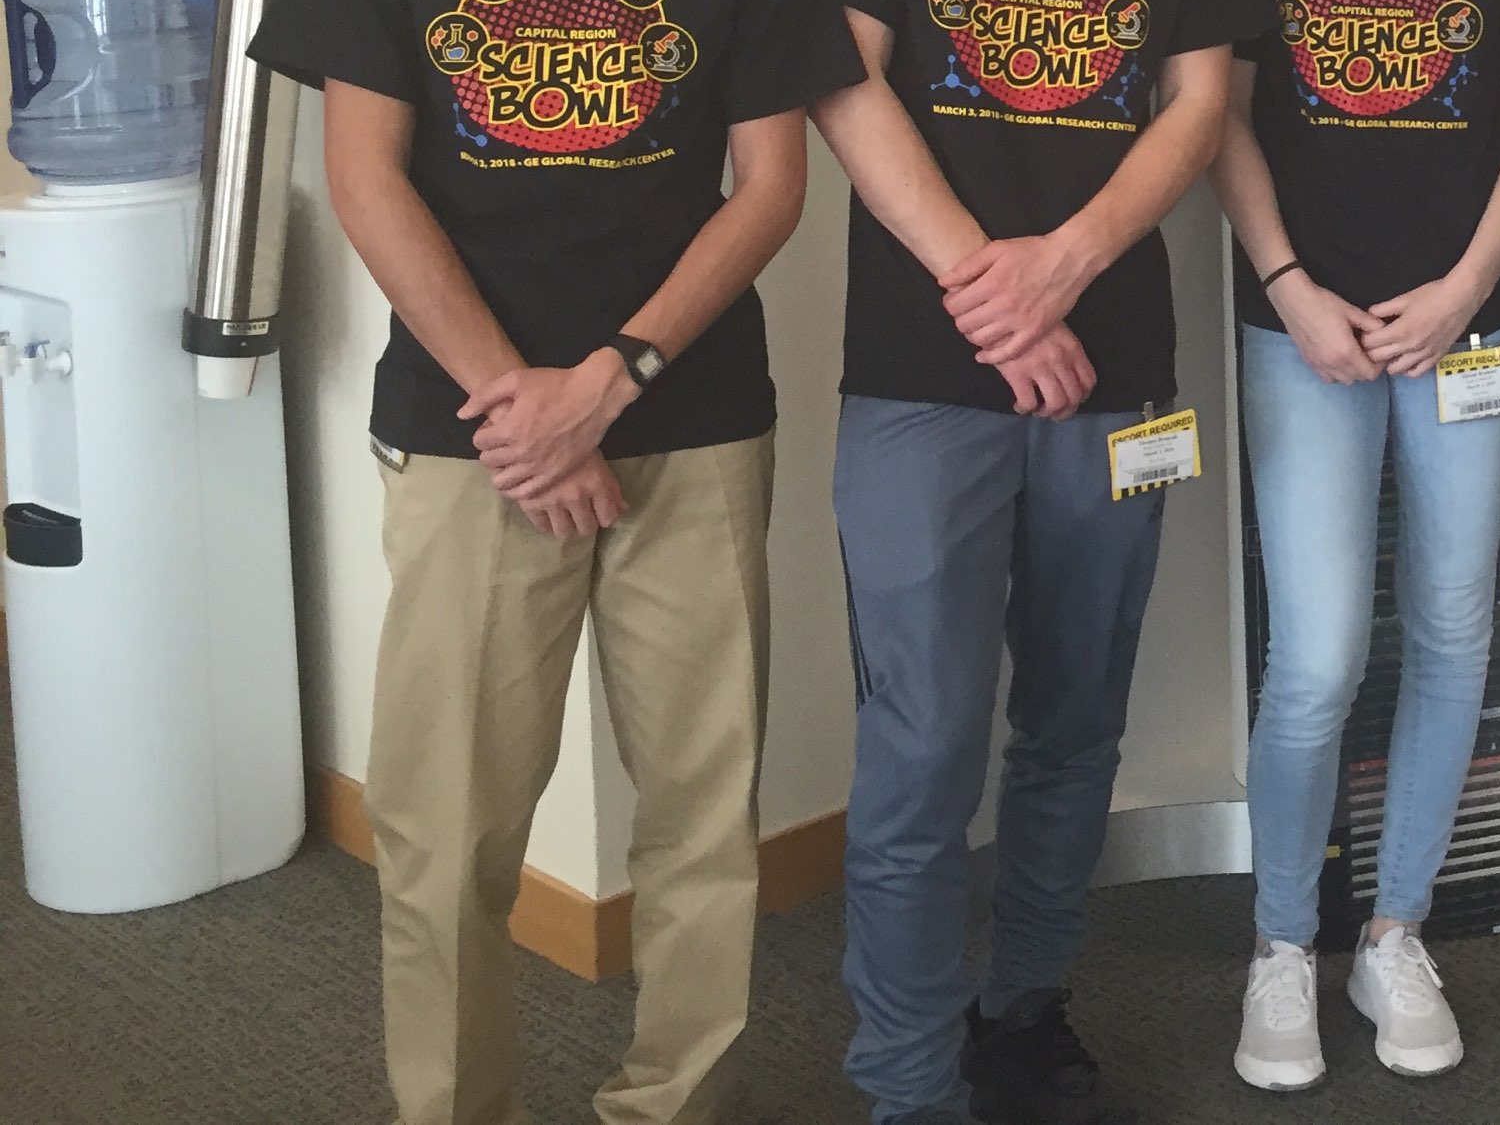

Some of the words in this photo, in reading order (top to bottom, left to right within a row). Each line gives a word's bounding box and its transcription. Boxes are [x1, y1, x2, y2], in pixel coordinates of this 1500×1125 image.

[1330, 5, 1373, 17] CAPITAL
[1374, 7, 1414, 18] REGION
[515, 27, 568, 40] CAPITAL
[569, 27, 616, 40] REGION
[970, 2, 1110, 53] SCIENCE
[1304, 16, 1439, 57] SCIENCE
[477, 40, 648, 87] SCIENCE
[979, 41, 1099, 89] BOWL
[1314, 49, 1429, 96] BOWL
[486, 81, 639, 131] BOWL
[932, 105, 967, 117] MARCH
[1016, 115, 1055, 126] GLOBAL
[1056, 117, 1105, 130] RESEARCH
[1106, 122, 1137, 132] CENTER
[1389, 120, 1435, 130] RESEARCH
[1436, 121, 1468, 130] CENTER
[489, 159, 516, 168] 2018
[523, 158, 539, 167] GE
[540, 156, 587, 166] GLOBAL
[637, 148, 676, 165] CENTER
[1440, 357, 1474, 370] ESCORT
[1149, 415, 1195, 437] REQUIRED
